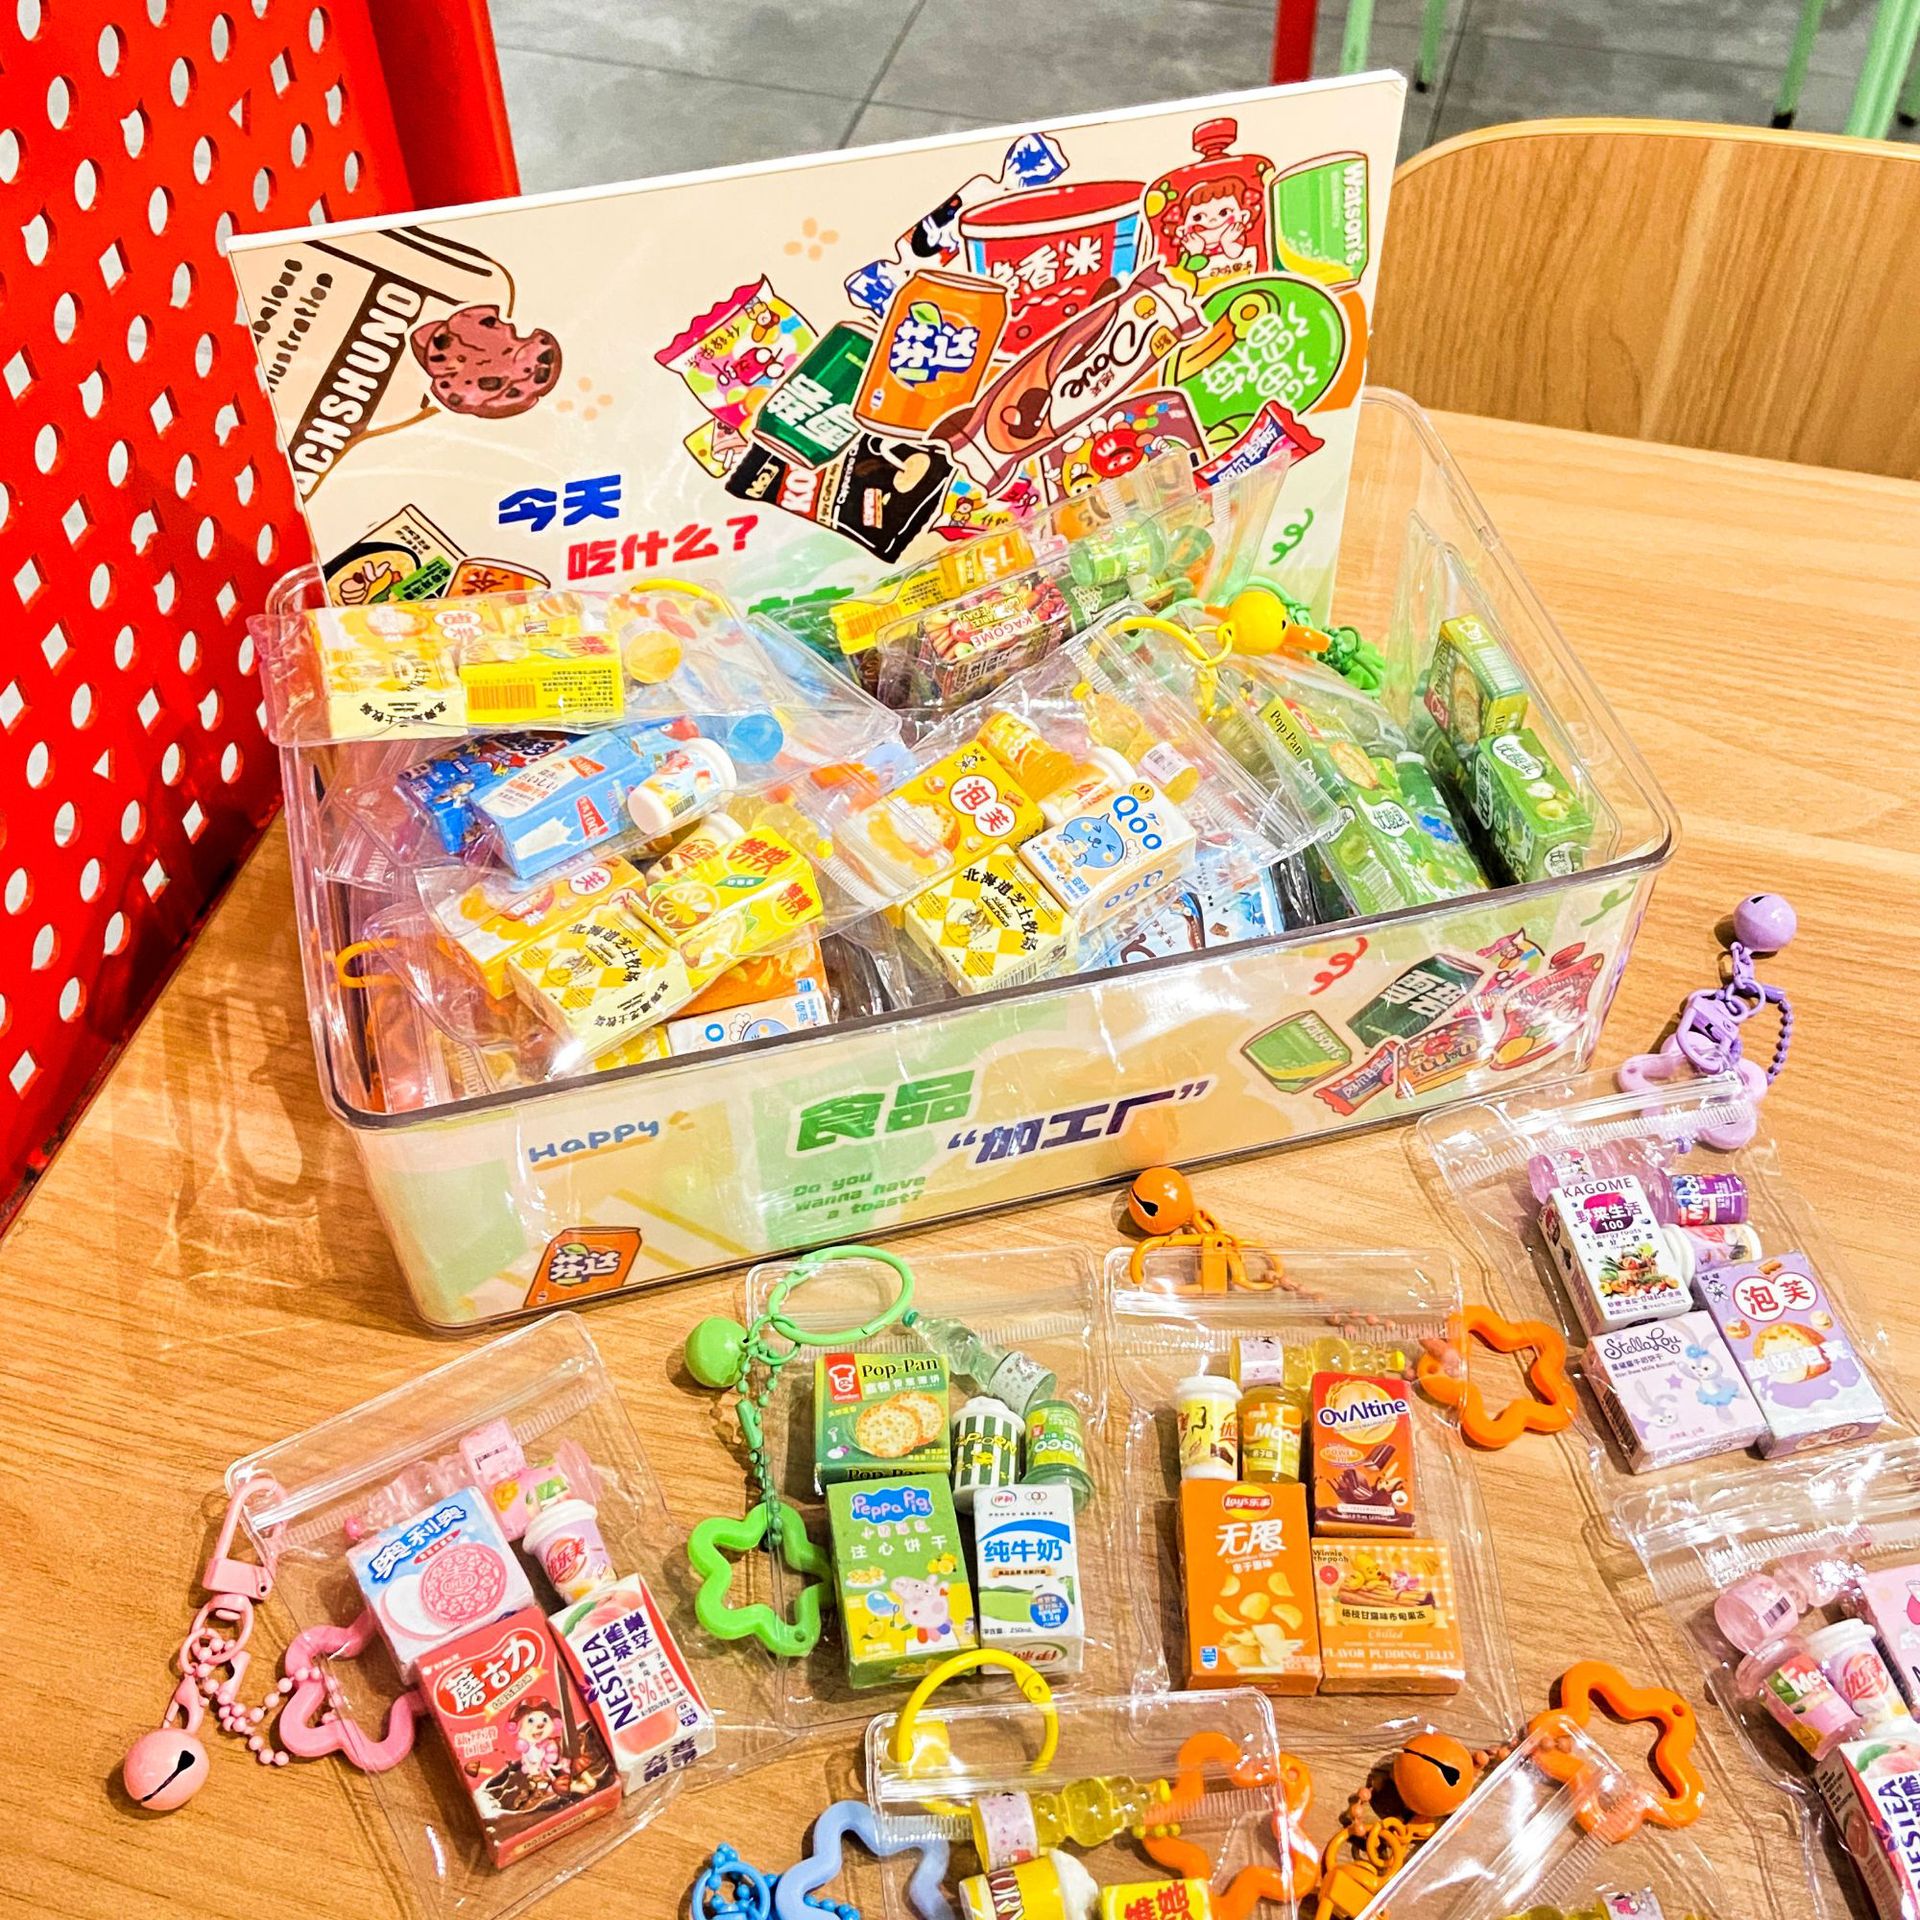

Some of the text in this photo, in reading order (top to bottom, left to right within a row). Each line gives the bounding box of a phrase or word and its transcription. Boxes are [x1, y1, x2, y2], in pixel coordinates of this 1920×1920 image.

[498, 474, 622, 532] 今天
[1270, 709, 1304, 756] Pop-Pan
[953, 779, 1012, 837] 泡芙
[1113, 795, 1163, 850] Qoo
[1298, 1013, 1345, 1061] Watson's
[796, 1069, 976, 1152] 食品
[793, 1170, 873, 1198] Do you
[871, 1174, 927, 1197] have
[1562, 1177, 1633, 1199] KAGOME
[850, 1189, 926, 1215] toast?
[1575, 1201, 1643, 1224] 野菜生活
[1602, 1219, 1625, 1231] 100
[1740, 1279, 1811, 1316] 泡芙
[861, 1358, 938, 1379] Pop-Pan
[854, 1489, 931, 1520] Peppa Pig
[370, 1505, 467, 1581] 奥利奥
[851, 1534, 948, 1560] 注心饼干
[984, 1537, 1063, 1563] 纯牛奶
[1215, 1518, 1288, 1557] 无限
[603, 1611, 648, 1645] 雀巢
[445, 1637, 537, 1714] 蘑古力
[582, 1632, 640, 1732] NESTEA
